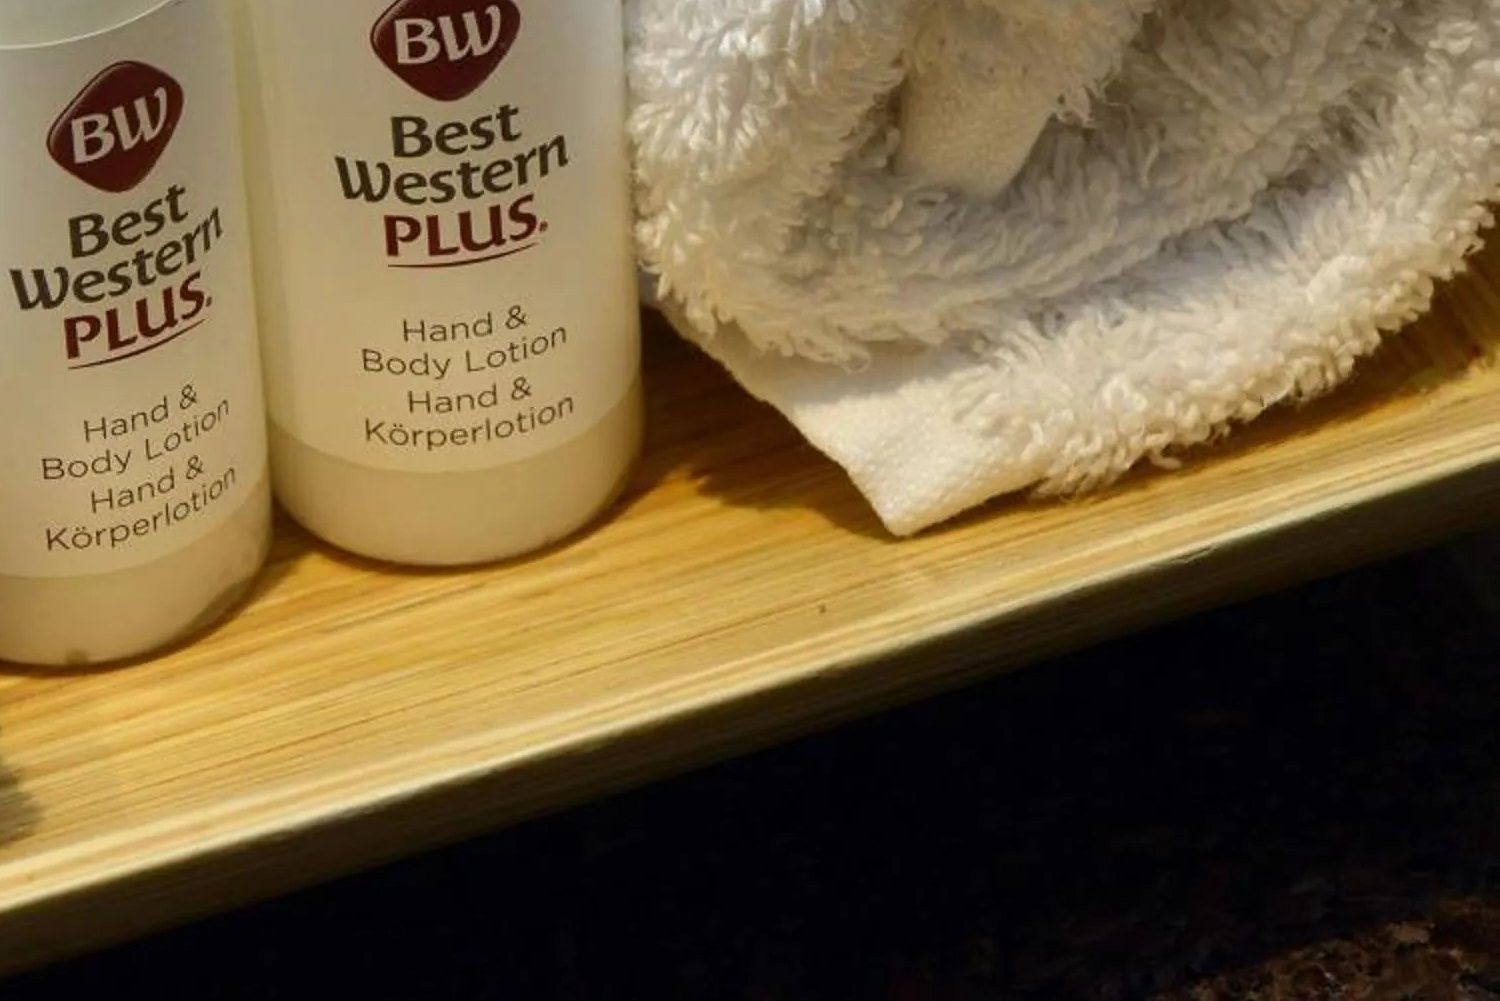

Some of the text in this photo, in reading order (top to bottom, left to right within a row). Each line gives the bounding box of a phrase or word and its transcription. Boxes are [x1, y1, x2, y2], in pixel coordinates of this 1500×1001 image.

[394, 4, 501, 65] BW
[71, 86, 167, 164] BW
[391, 104, 522, 158] Best
[334, 134, 569, 205] Western
[68, 184, 188, 258] Best
[9, 206, 224, 311] Western
[362, 326, 567, 380] Body Lotion
[403, 304, 527, 342] Hand &
[83, 384, 198, 443] Hand &
[364, 396, 575, 451] Körperlotion
[408, 376, 532, 414] Hand &
[41, 399, 230, 481] Body Lotion
[45, 467, 237, 551] Körperlotion
[91, 455, 205, 514] Hand &
